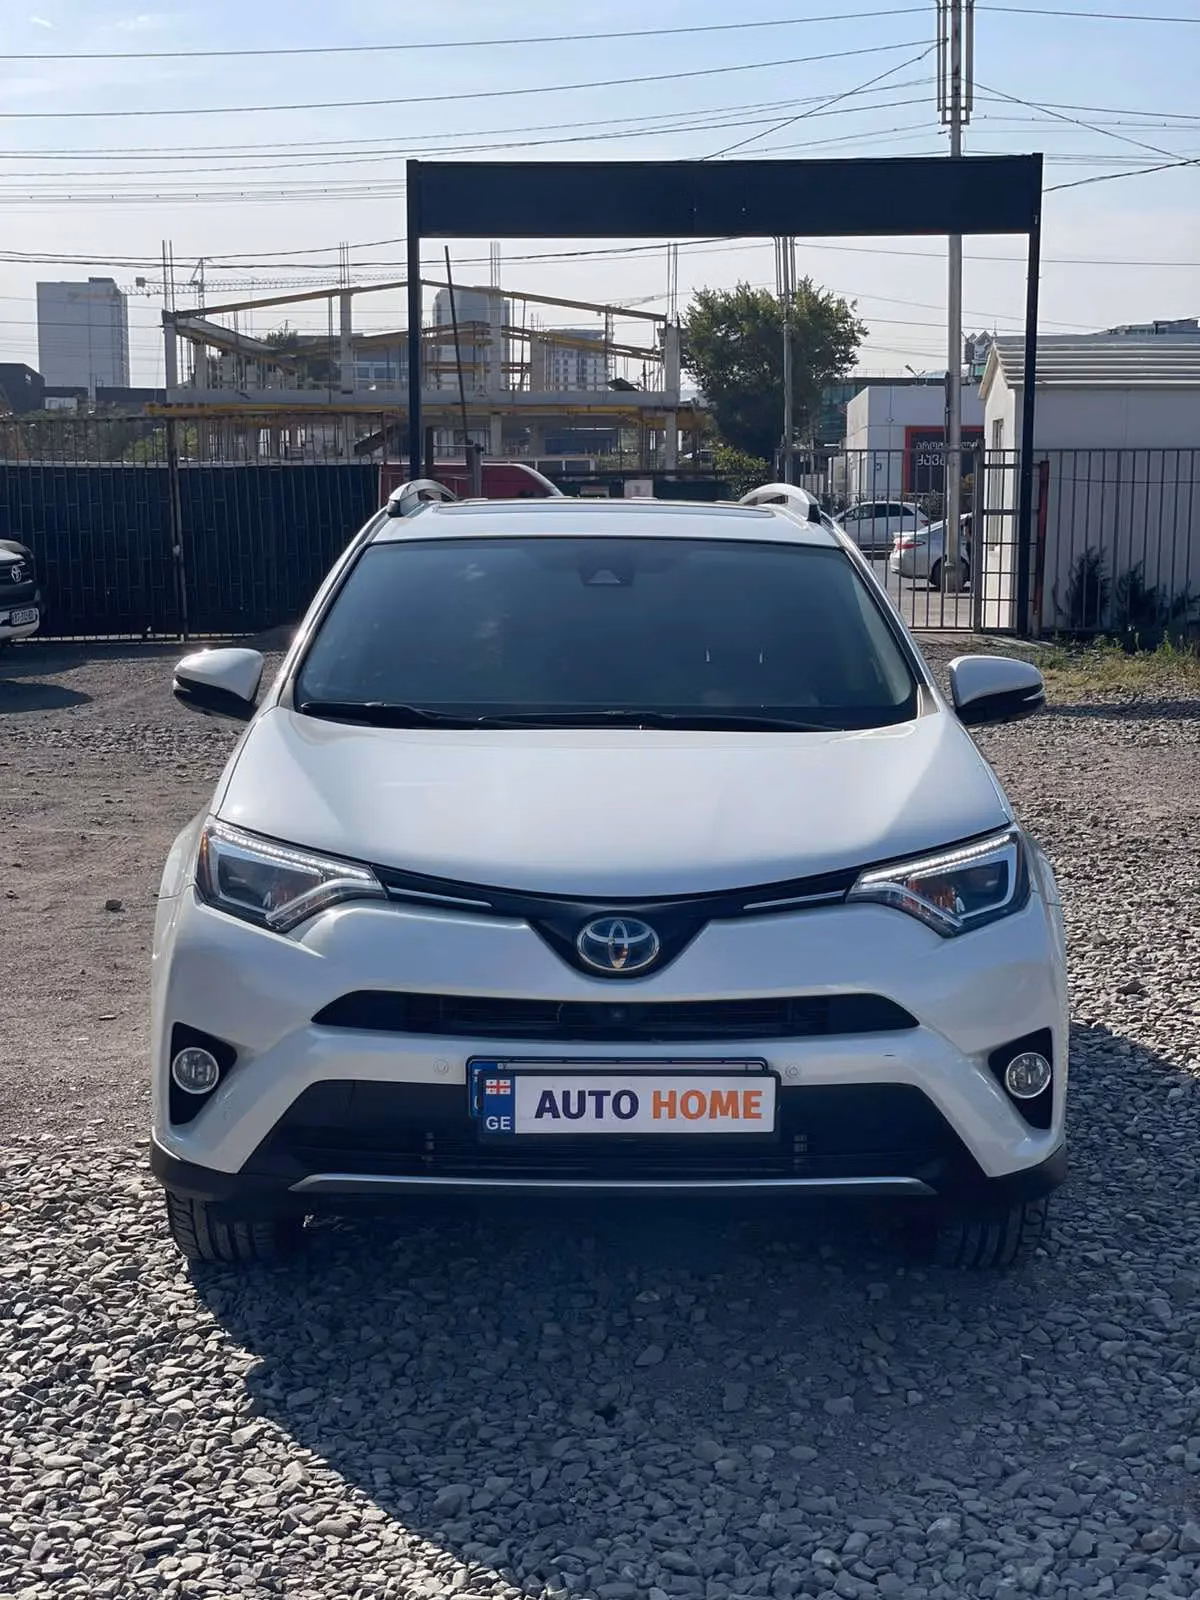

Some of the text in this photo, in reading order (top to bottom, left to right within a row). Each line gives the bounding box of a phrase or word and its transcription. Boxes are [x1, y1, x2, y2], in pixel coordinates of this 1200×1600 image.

[534, 1089, 763, 1120] AUTO HOME
[486, 1116, 511, 1130] GE
